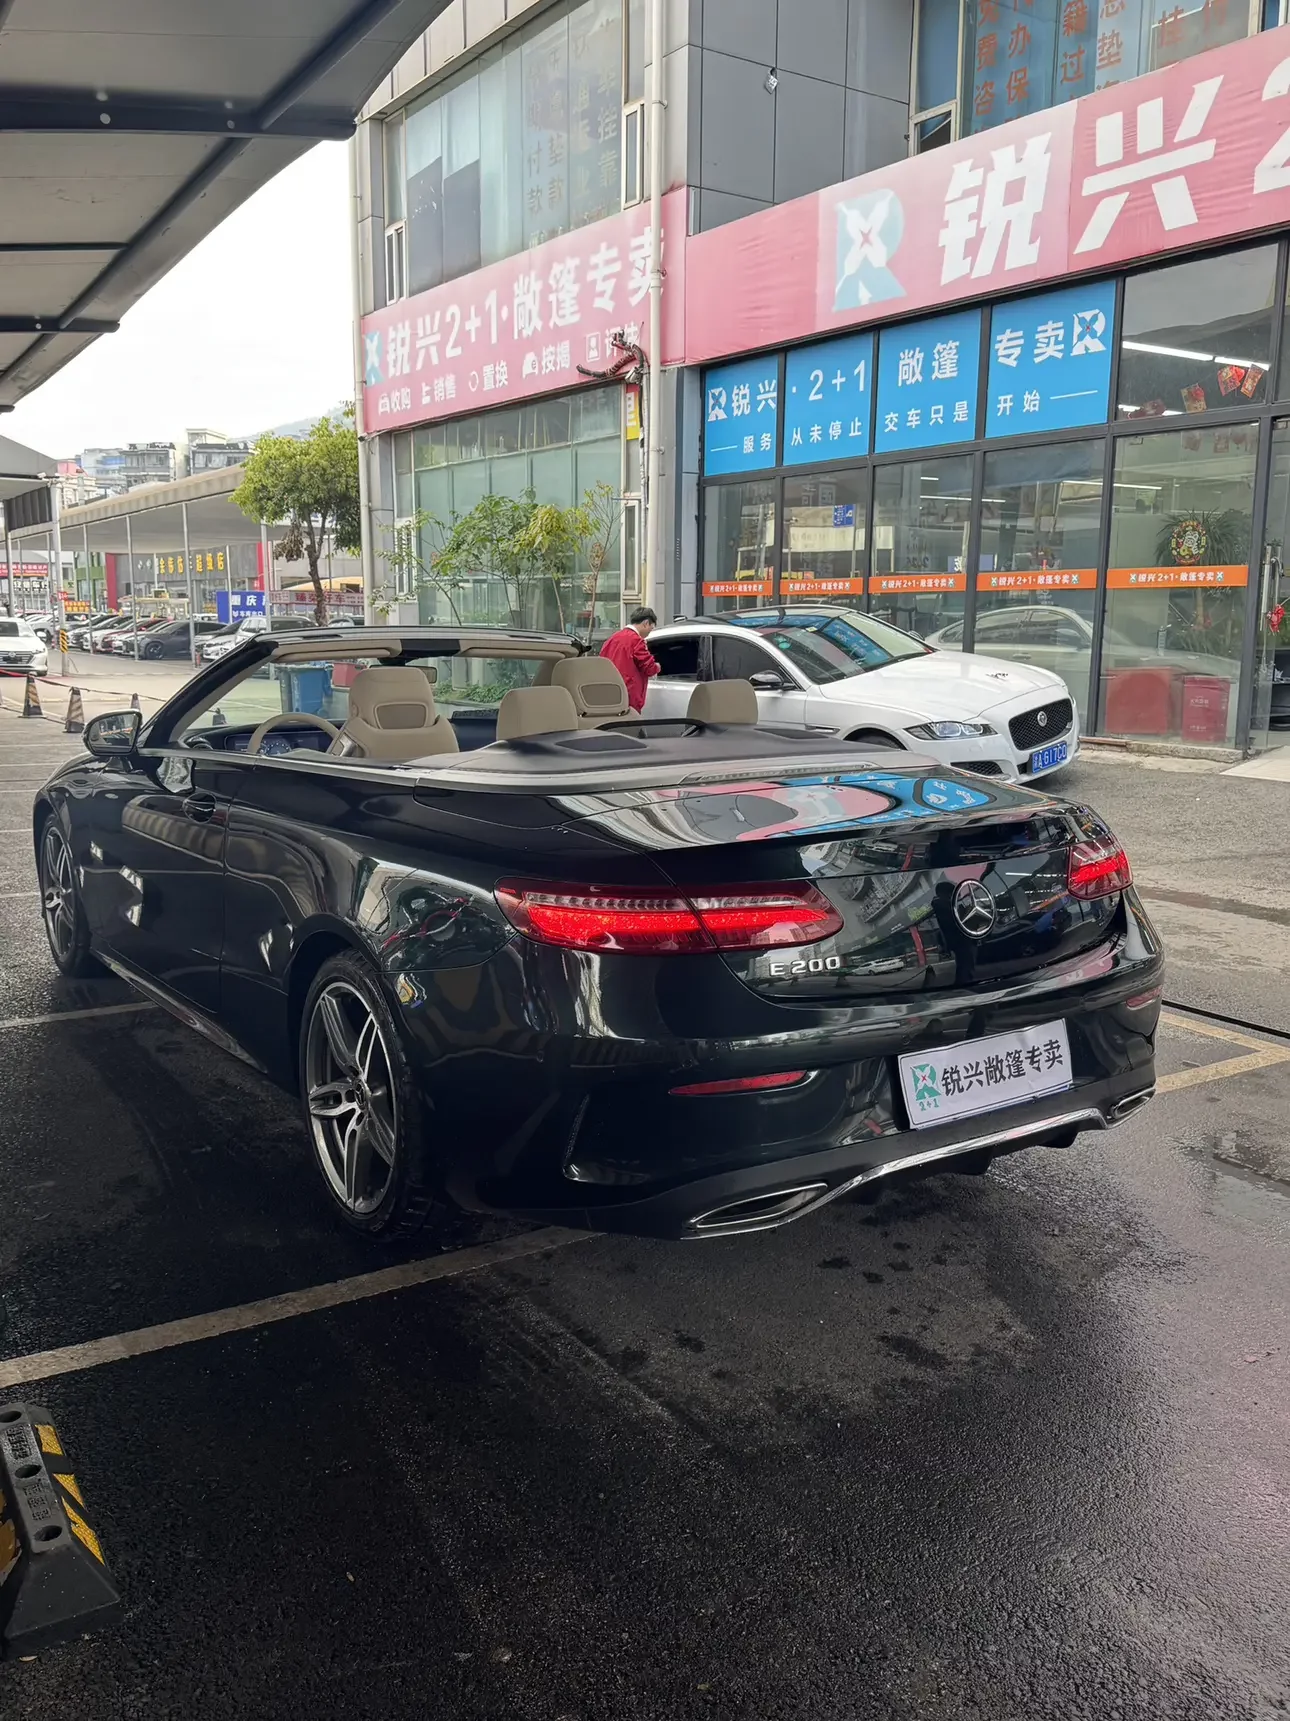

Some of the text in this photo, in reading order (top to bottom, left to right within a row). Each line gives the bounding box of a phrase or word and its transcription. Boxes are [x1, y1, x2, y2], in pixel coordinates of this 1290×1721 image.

[482, 359, 509, 391] 置换
[542, 340, 570, 375] 按揭
[731, 378, 778, 417] 锐兴
[897, 339, 960, 388] 敞篷
[994, 319, 1066, 368] 专卖
[743, 389, 1041, 454] 服务 从未停止 交车只是 开始
[769, 956, 841, 976] E 200
[941, 1038, 1064, 1097] 锐兴敞篷专卖
[918, 1098, 941, 1112] 2+1
